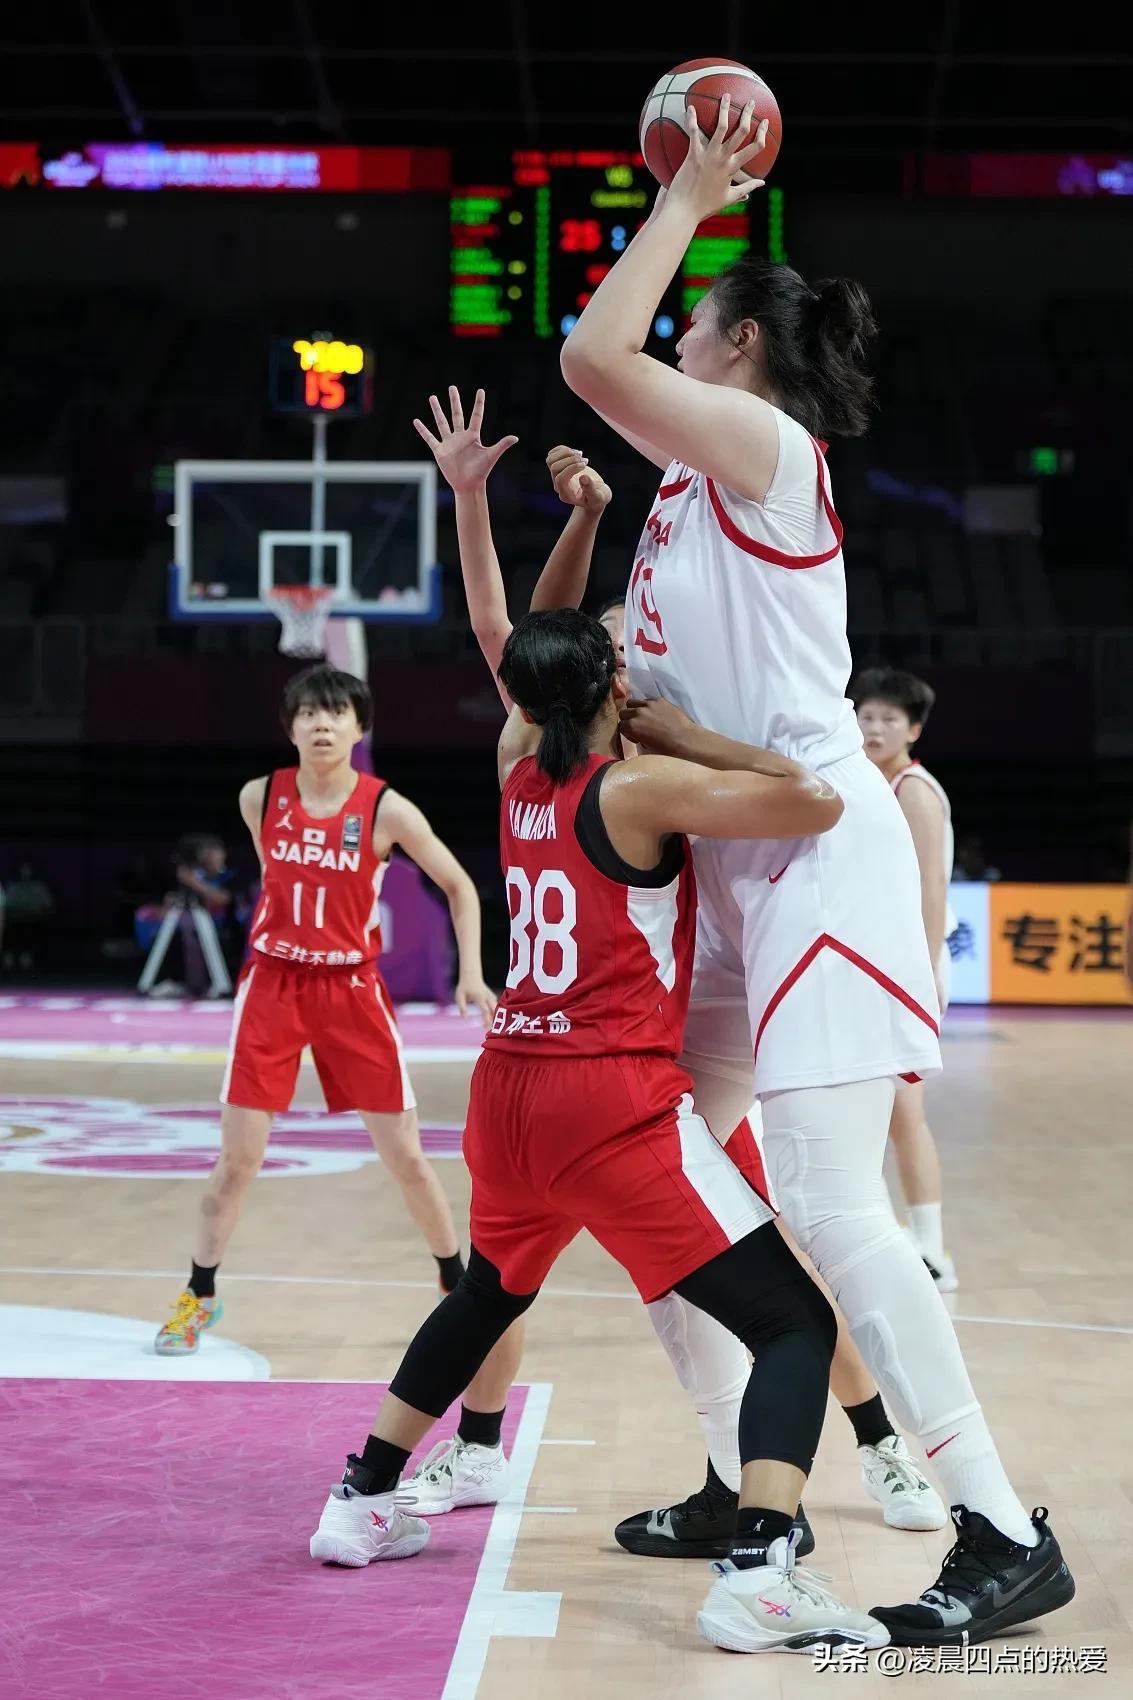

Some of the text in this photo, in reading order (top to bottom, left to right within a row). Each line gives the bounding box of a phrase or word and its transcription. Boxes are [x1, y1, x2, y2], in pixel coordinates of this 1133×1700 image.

[305, 370, 346, 410] 15
[509, 799, 557, 840] YAMADA
[270, 840, 361, 872] JAPAN
[293, 882, 326, 929] 11
[1003, 913, 1124, 972] 专注
